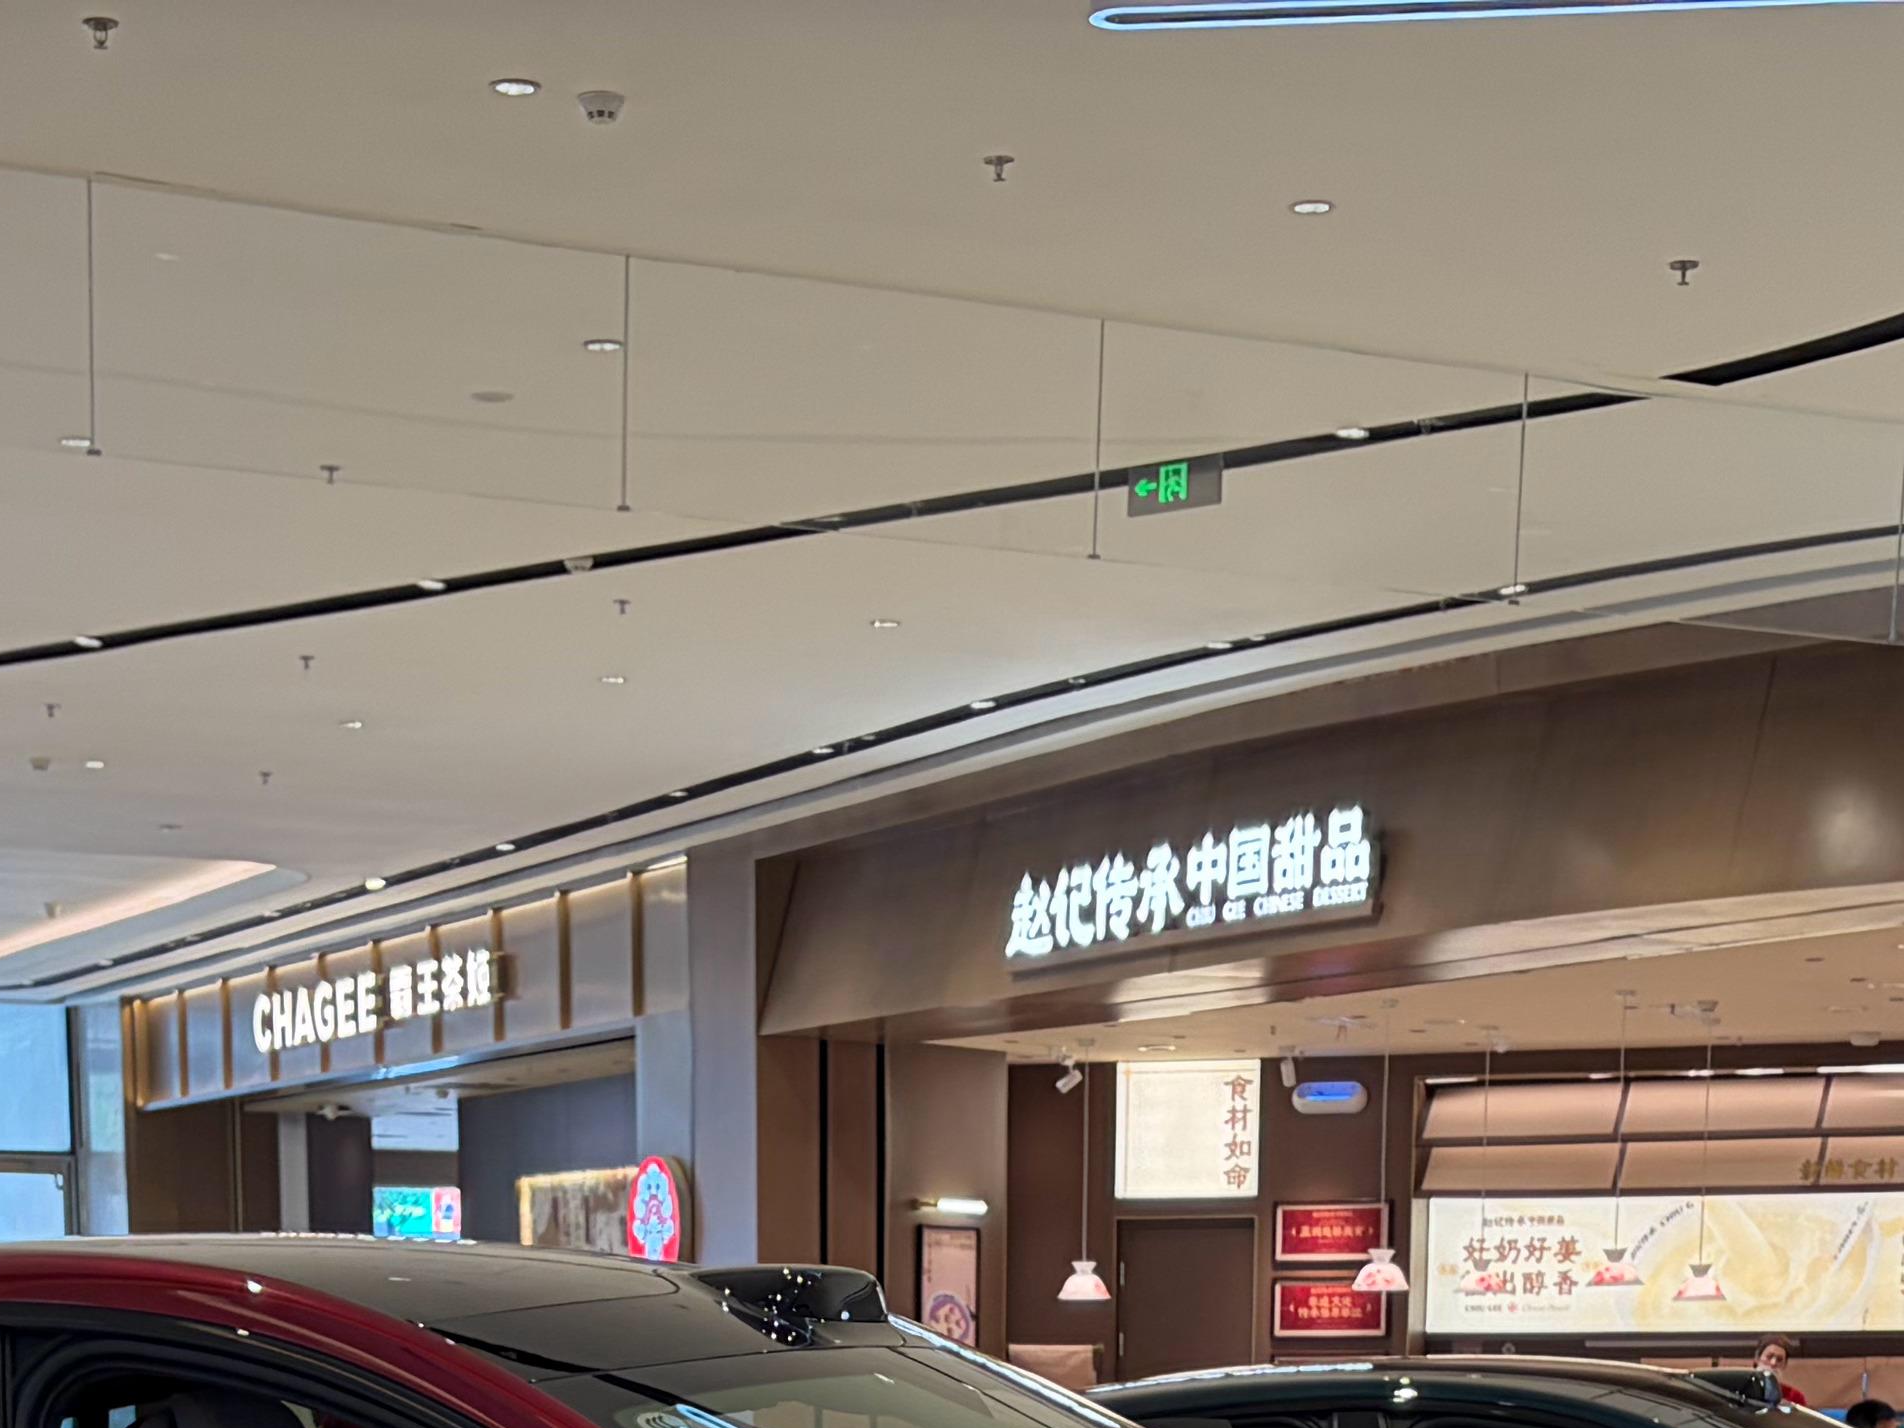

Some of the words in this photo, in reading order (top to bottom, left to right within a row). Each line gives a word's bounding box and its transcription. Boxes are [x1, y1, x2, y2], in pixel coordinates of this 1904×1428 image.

[252, 969, 378, 1054] CHAGEE
[388, 947, 493, 1022] 霸王茶姬
[1222, 1074, 1255, 1191] 食材如命
